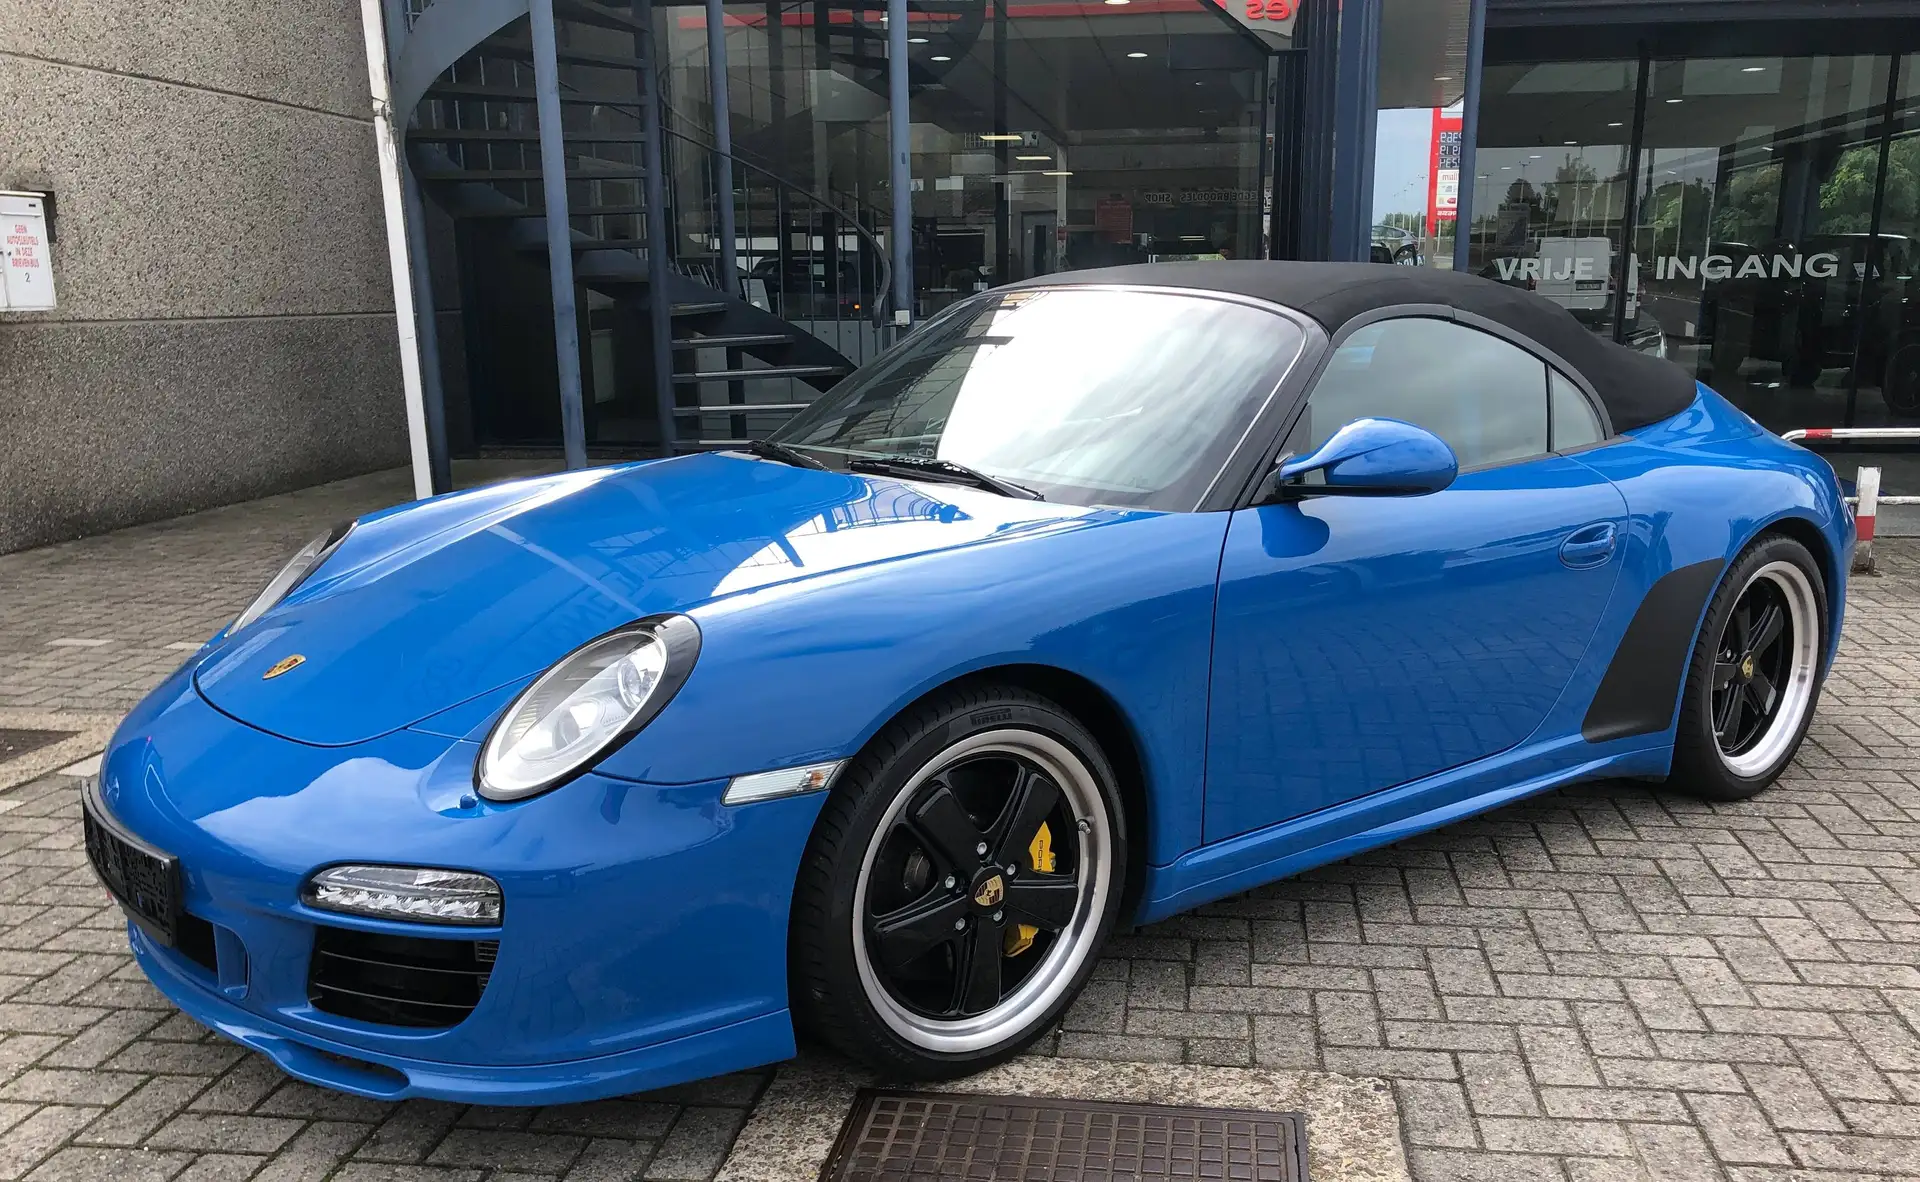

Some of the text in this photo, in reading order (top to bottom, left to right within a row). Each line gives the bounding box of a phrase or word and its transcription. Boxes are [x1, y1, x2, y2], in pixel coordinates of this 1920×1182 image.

[1496, 253, 1838, 281] VRIJE INGANG
[25, 272, 31, 283] 2
